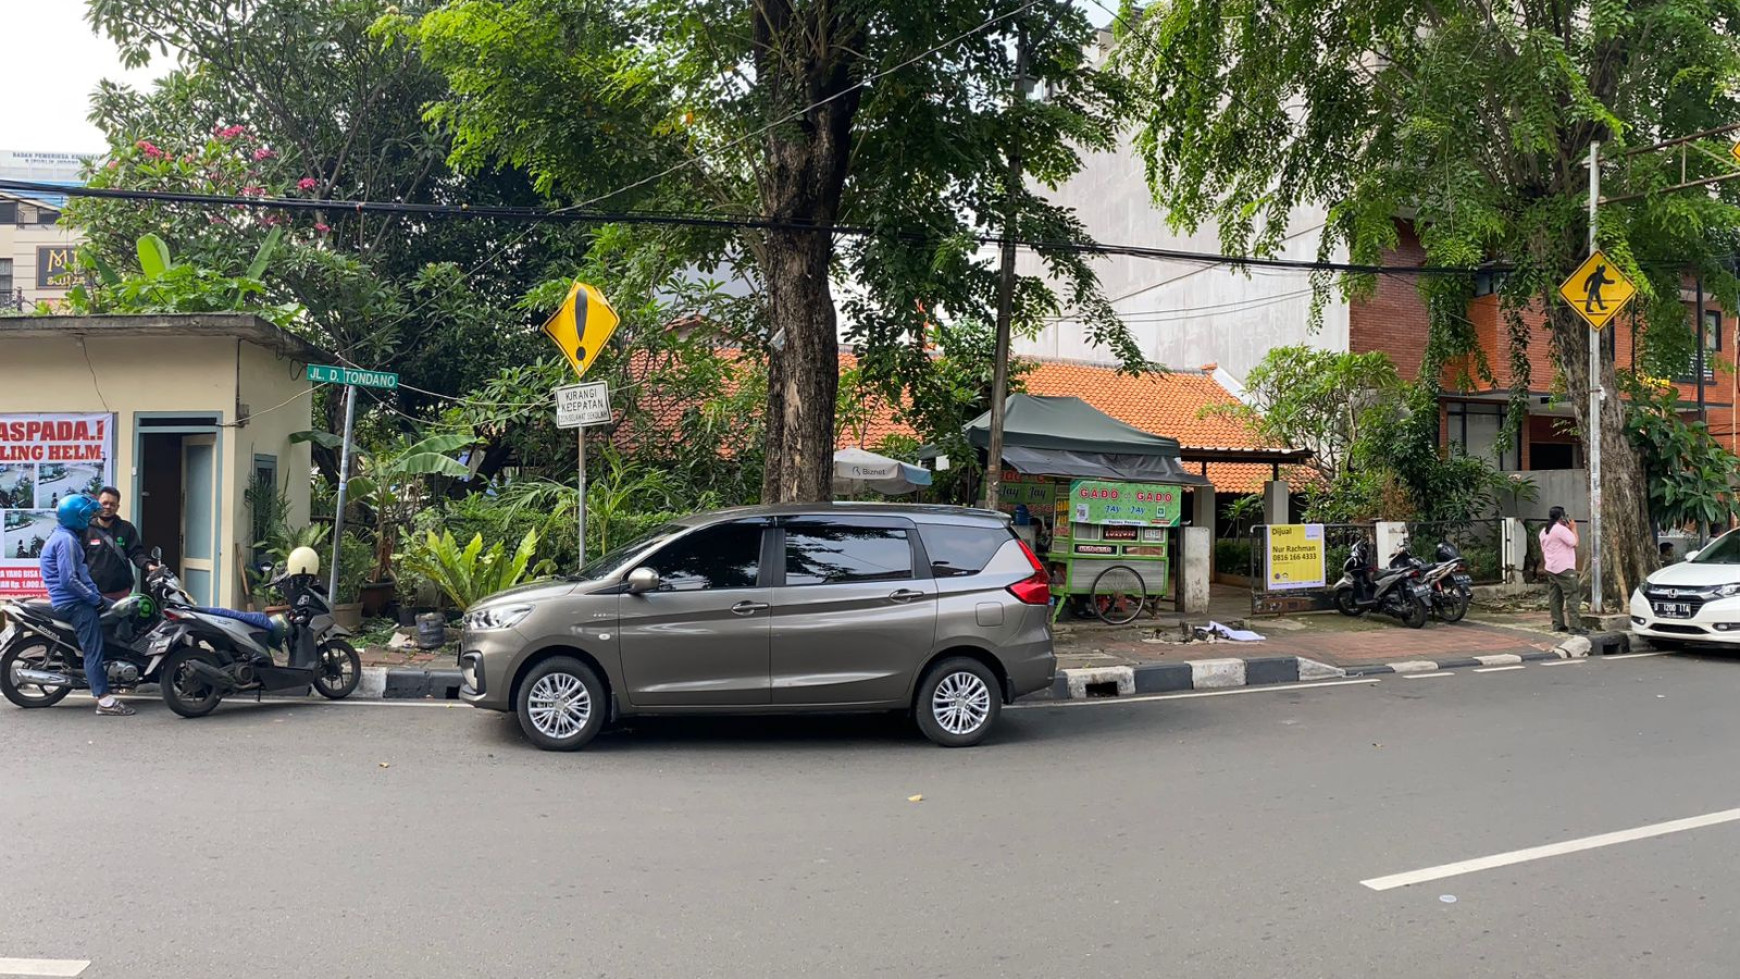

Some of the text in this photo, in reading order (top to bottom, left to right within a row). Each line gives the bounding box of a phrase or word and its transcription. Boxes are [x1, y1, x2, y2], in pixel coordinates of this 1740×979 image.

[310, 367, 395, 388] JL. D. TONDANO
[48, 444, 102, 460] HELM
[1080, 487, 1172, 502] GADO GADO
[1271, 528, 1292, 536] Dijual
[23, 570, 38, 578] BISA
